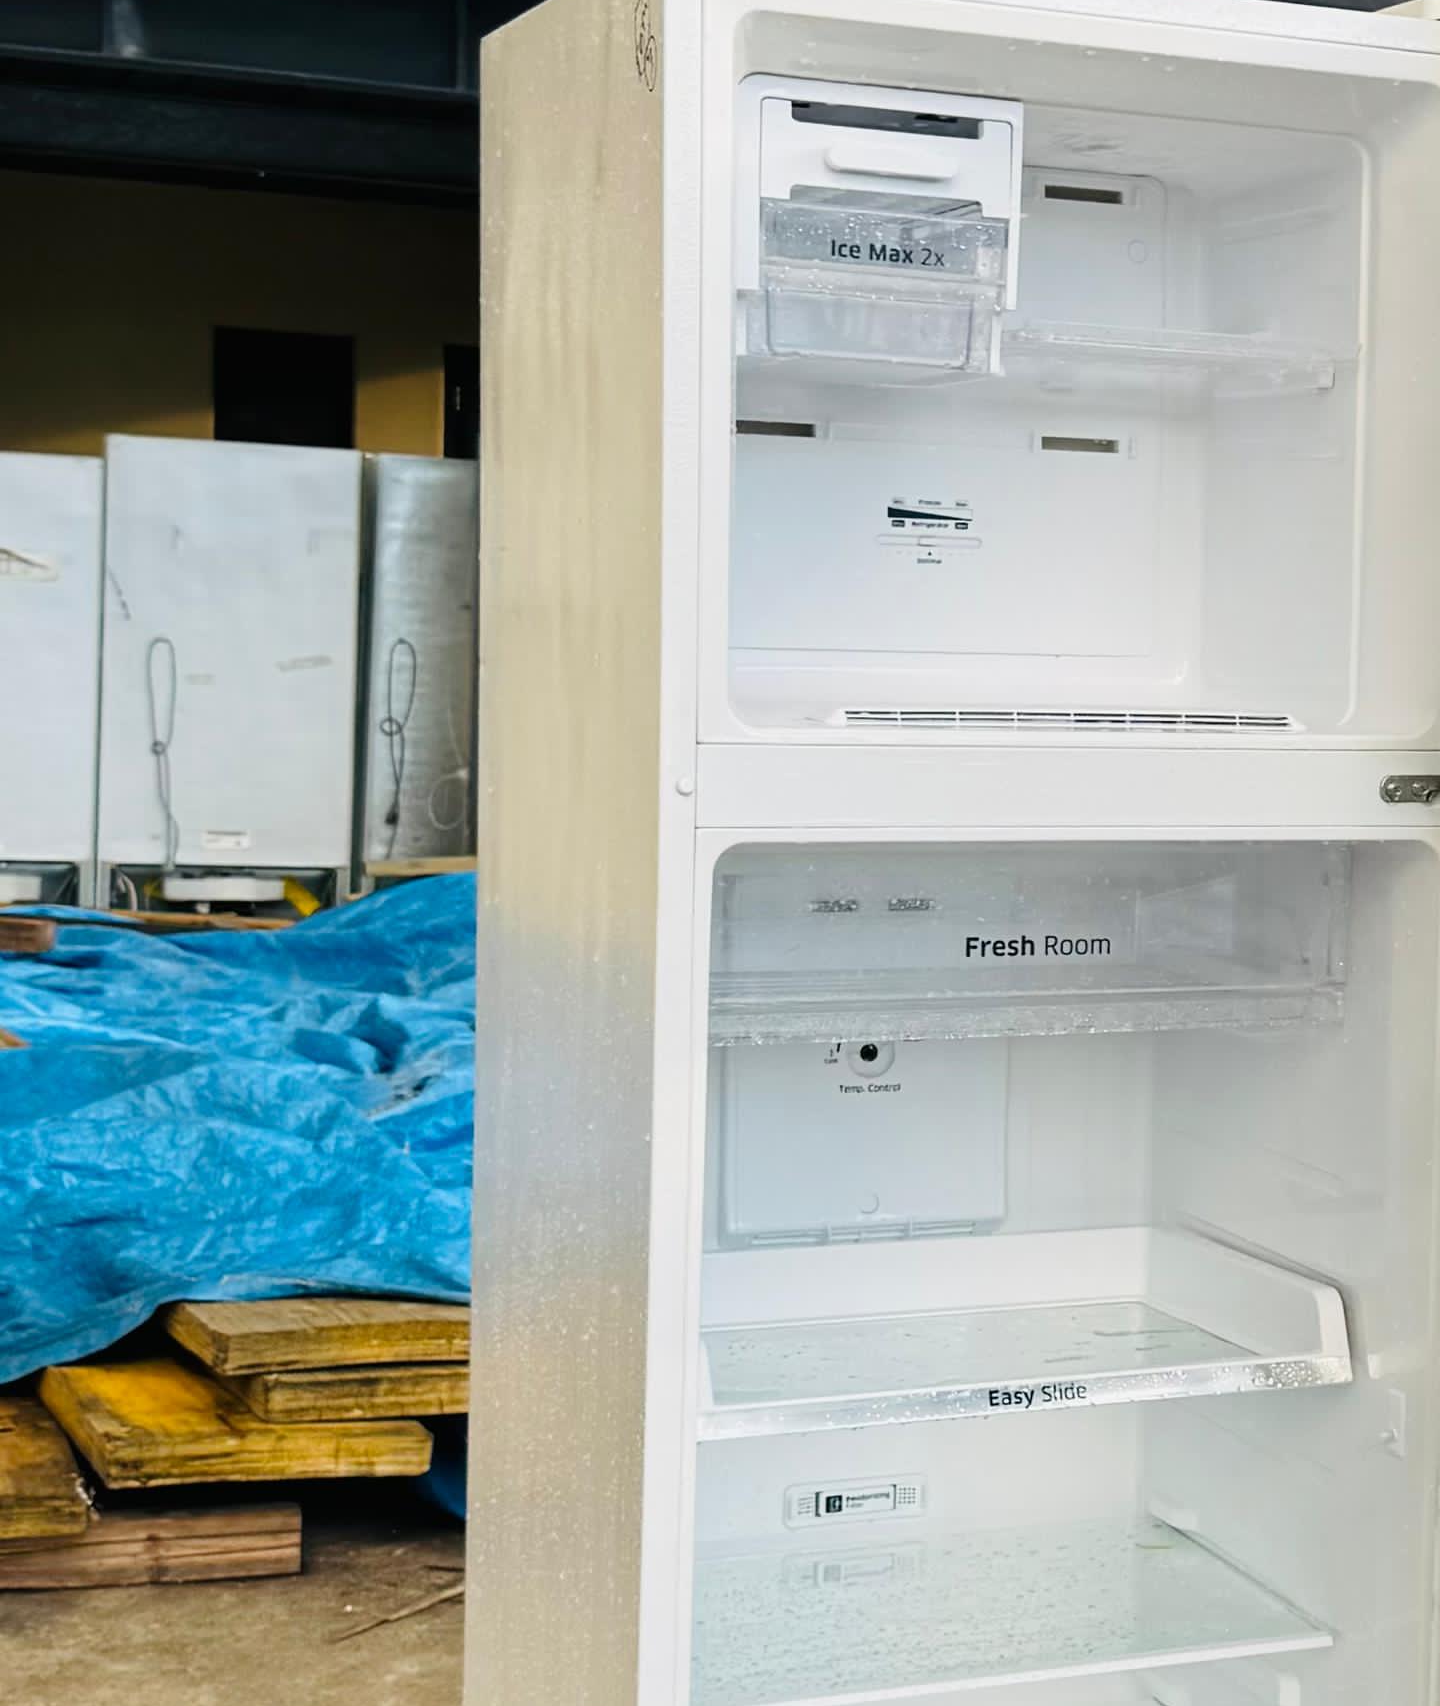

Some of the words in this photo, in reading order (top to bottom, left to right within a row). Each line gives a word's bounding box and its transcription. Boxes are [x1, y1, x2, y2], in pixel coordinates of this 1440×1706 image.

[831, 239, 861, 259] Ice
[869, 242, 914, 264] Max
[920, 247, 945, 267] 2x
[965, 935, 1035, 958] Fresh
[1044, 935, 1112, 956] Room
[867, 1083, 902, 1093] Control
[988, 1389, 1035, 1409] Easy
[1040, 1382, 1088, 1403] Slide
